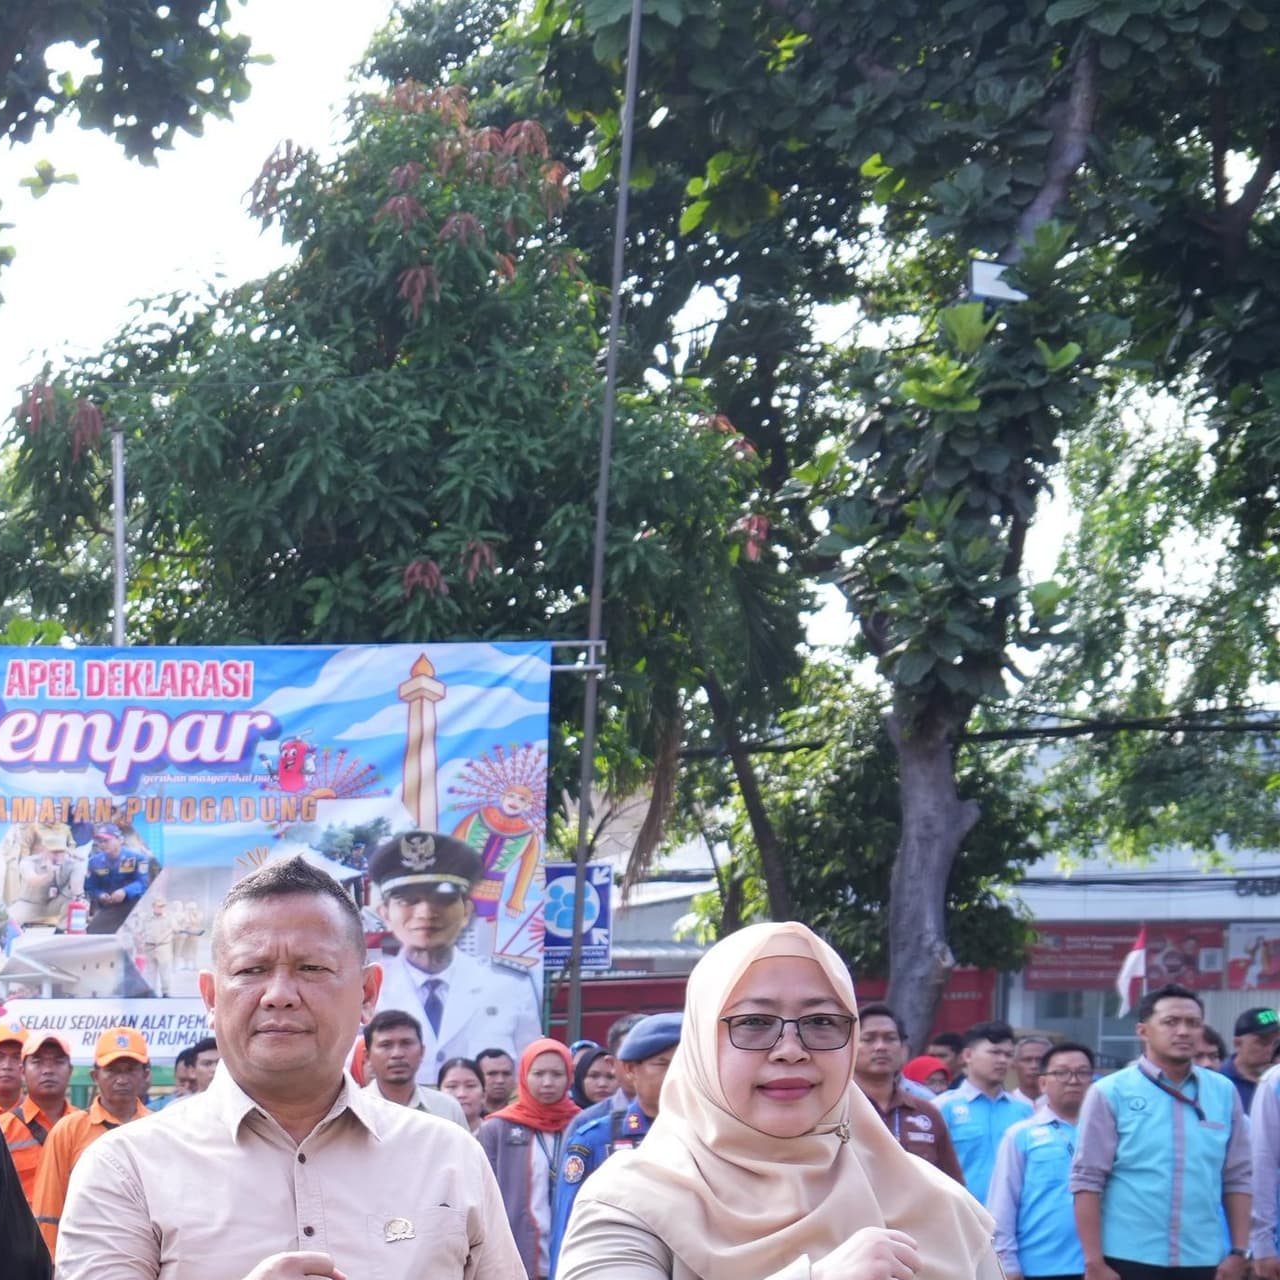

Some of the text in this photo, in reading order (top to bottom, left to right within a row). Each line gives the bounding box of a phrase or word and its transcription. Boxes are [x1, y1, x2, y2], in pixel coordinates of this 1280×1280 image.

[5, 660, 254, 698] APEL DEKLARASI
[125, 795, 317, 824] PULOGADUNG
[19, 1015, 66, 1030] SELALU
[69, 1015, 138, 1029] SEDIAKAN
[140, 1015, 172, 1029] ALAT
[157, 1031, 209, 1046] RUMAH
